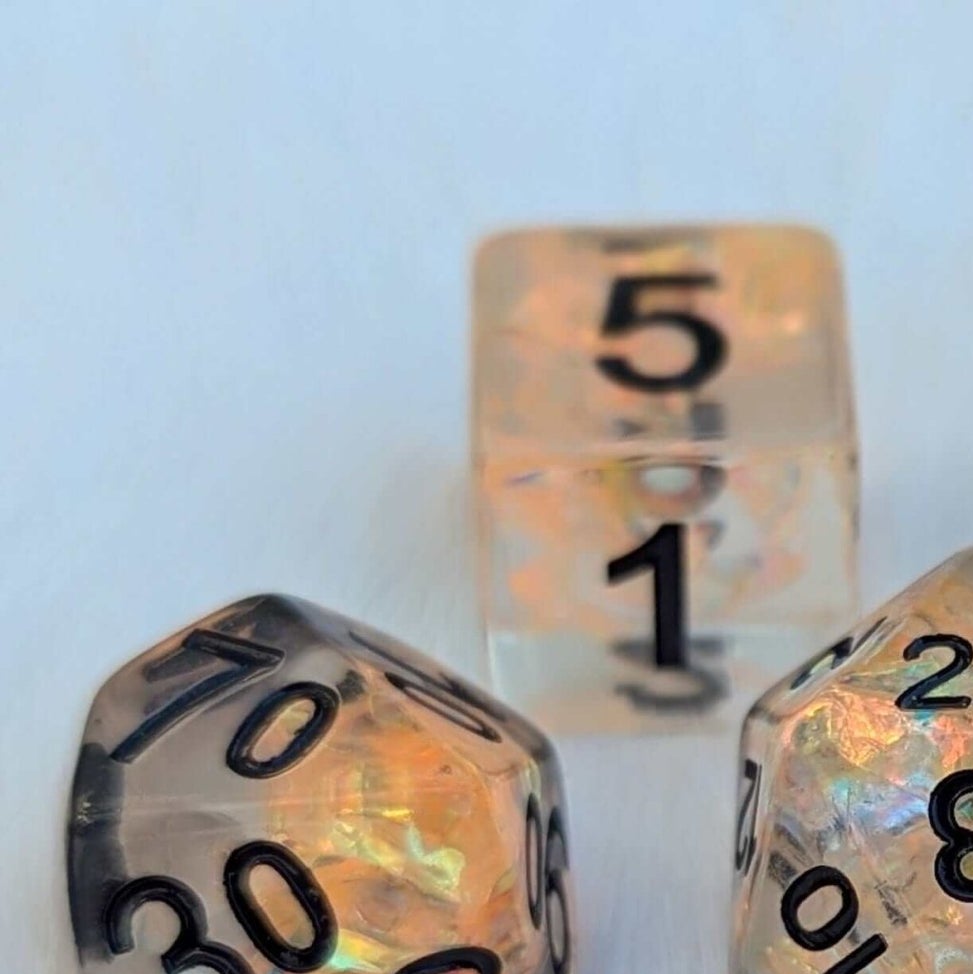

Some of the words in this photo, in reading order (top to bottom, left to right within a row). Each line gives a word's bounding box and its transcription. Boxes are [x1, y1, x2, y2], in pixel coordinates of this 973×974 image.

[595, 272, 729, 392] 5
[607, 522, 687, 669] 1
[109, 629, 341, 779] 70
